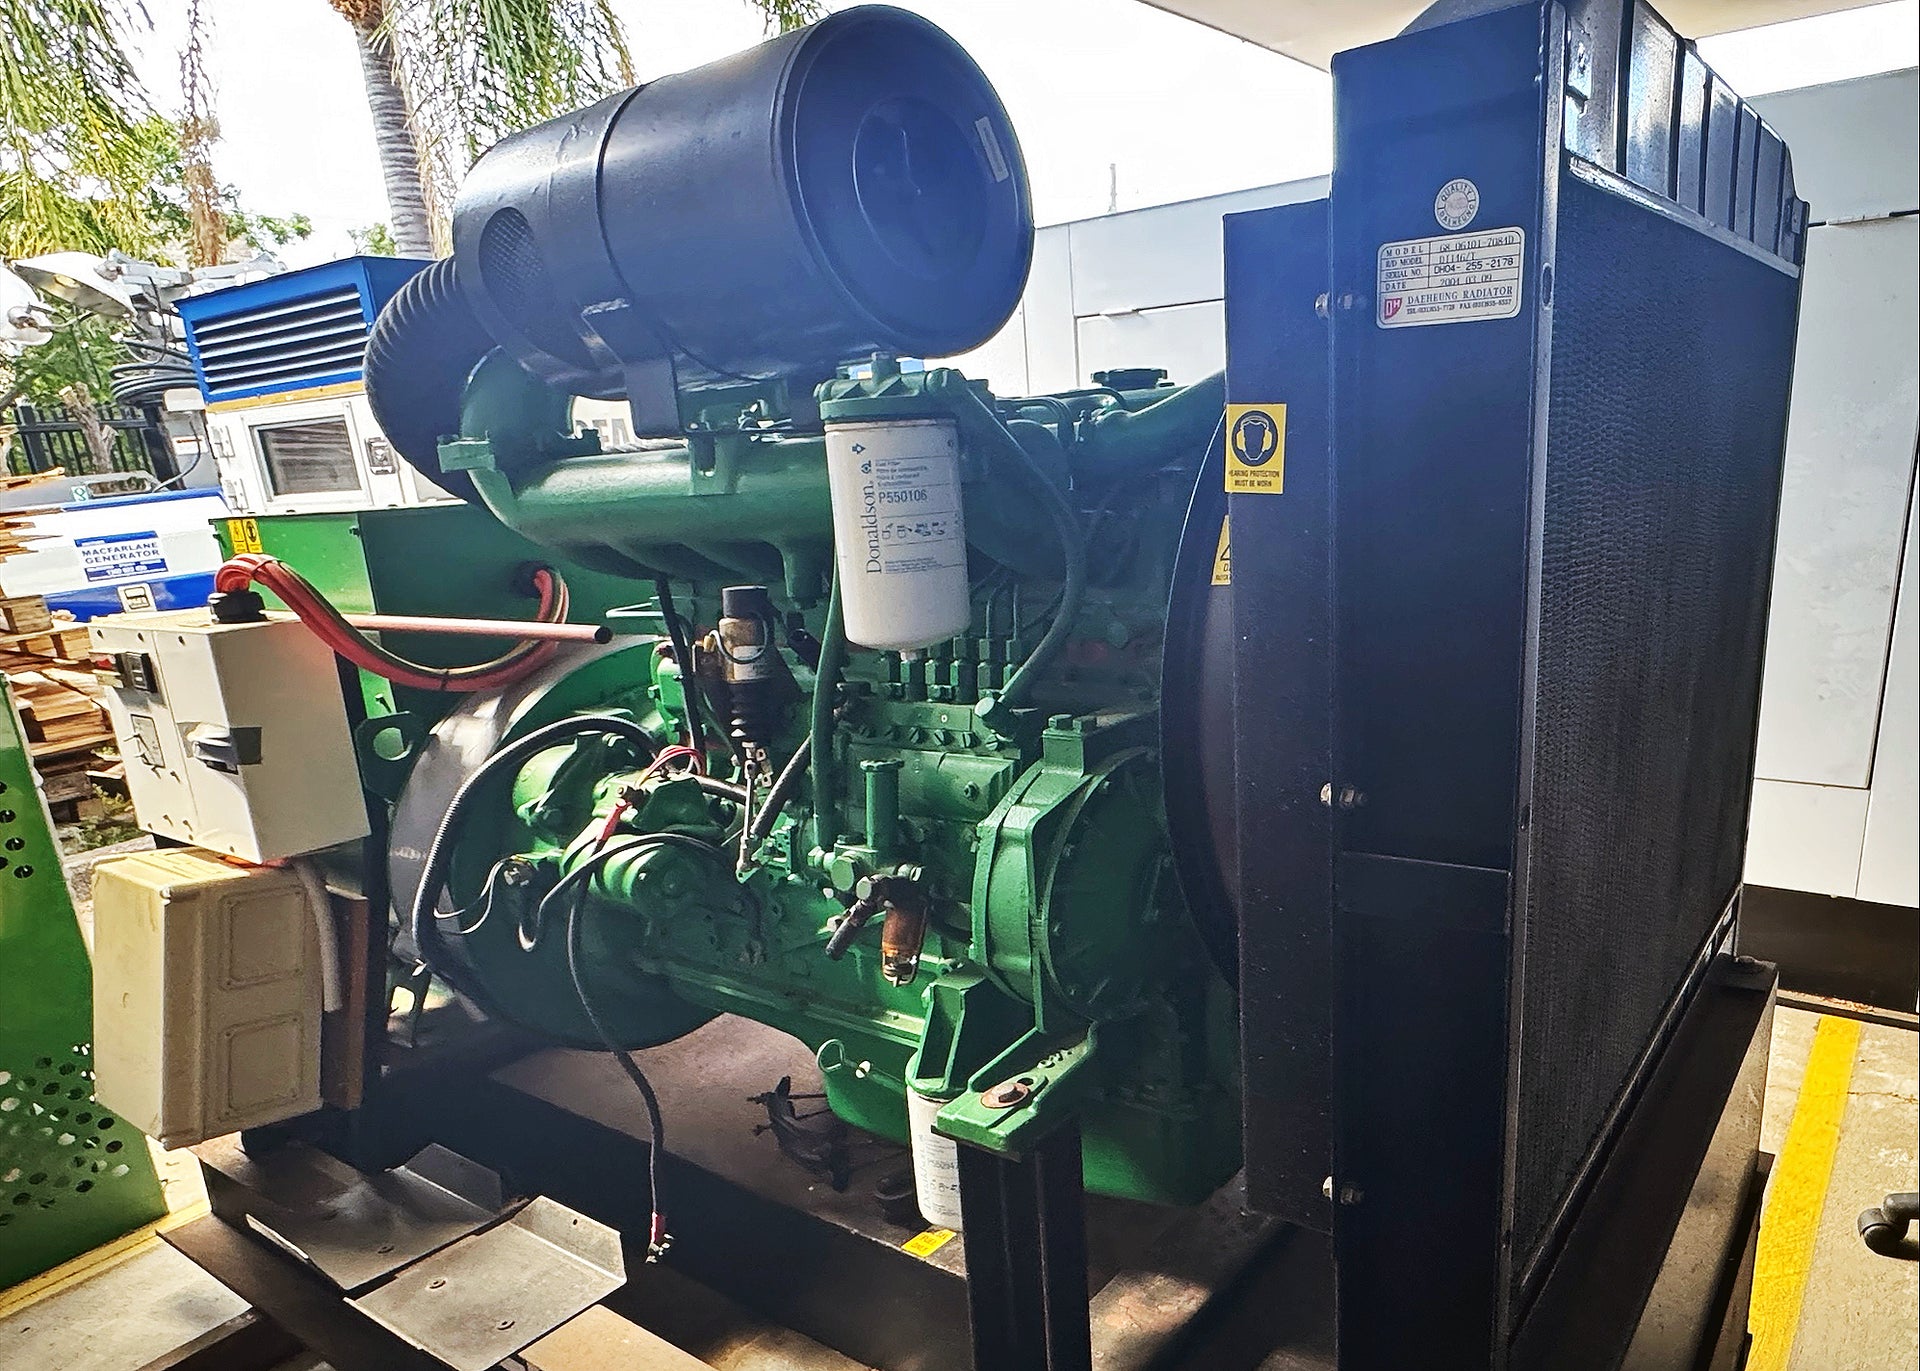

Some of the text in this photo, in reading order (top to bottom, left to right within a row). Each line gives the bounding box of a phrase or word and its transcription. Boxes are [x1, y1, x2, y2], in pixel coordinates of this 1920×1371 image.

[1441, 183, 1472, 202] QUALITY
[1386, 245, 1423, 257] MODEL
[1400, 257, 1422, 266] MODEL
[1385, 281, 1406, 291] DATE
[1407, 285, 1513, 305] DAEHEUNG RADIATOR
[1250, 469, 1280, 478] PROTECTION
[878, 489, 928, 503] P550106
[82, 542, 158, 557] MACFARLANE
[85, 549, 160, 564] GENERATOR
